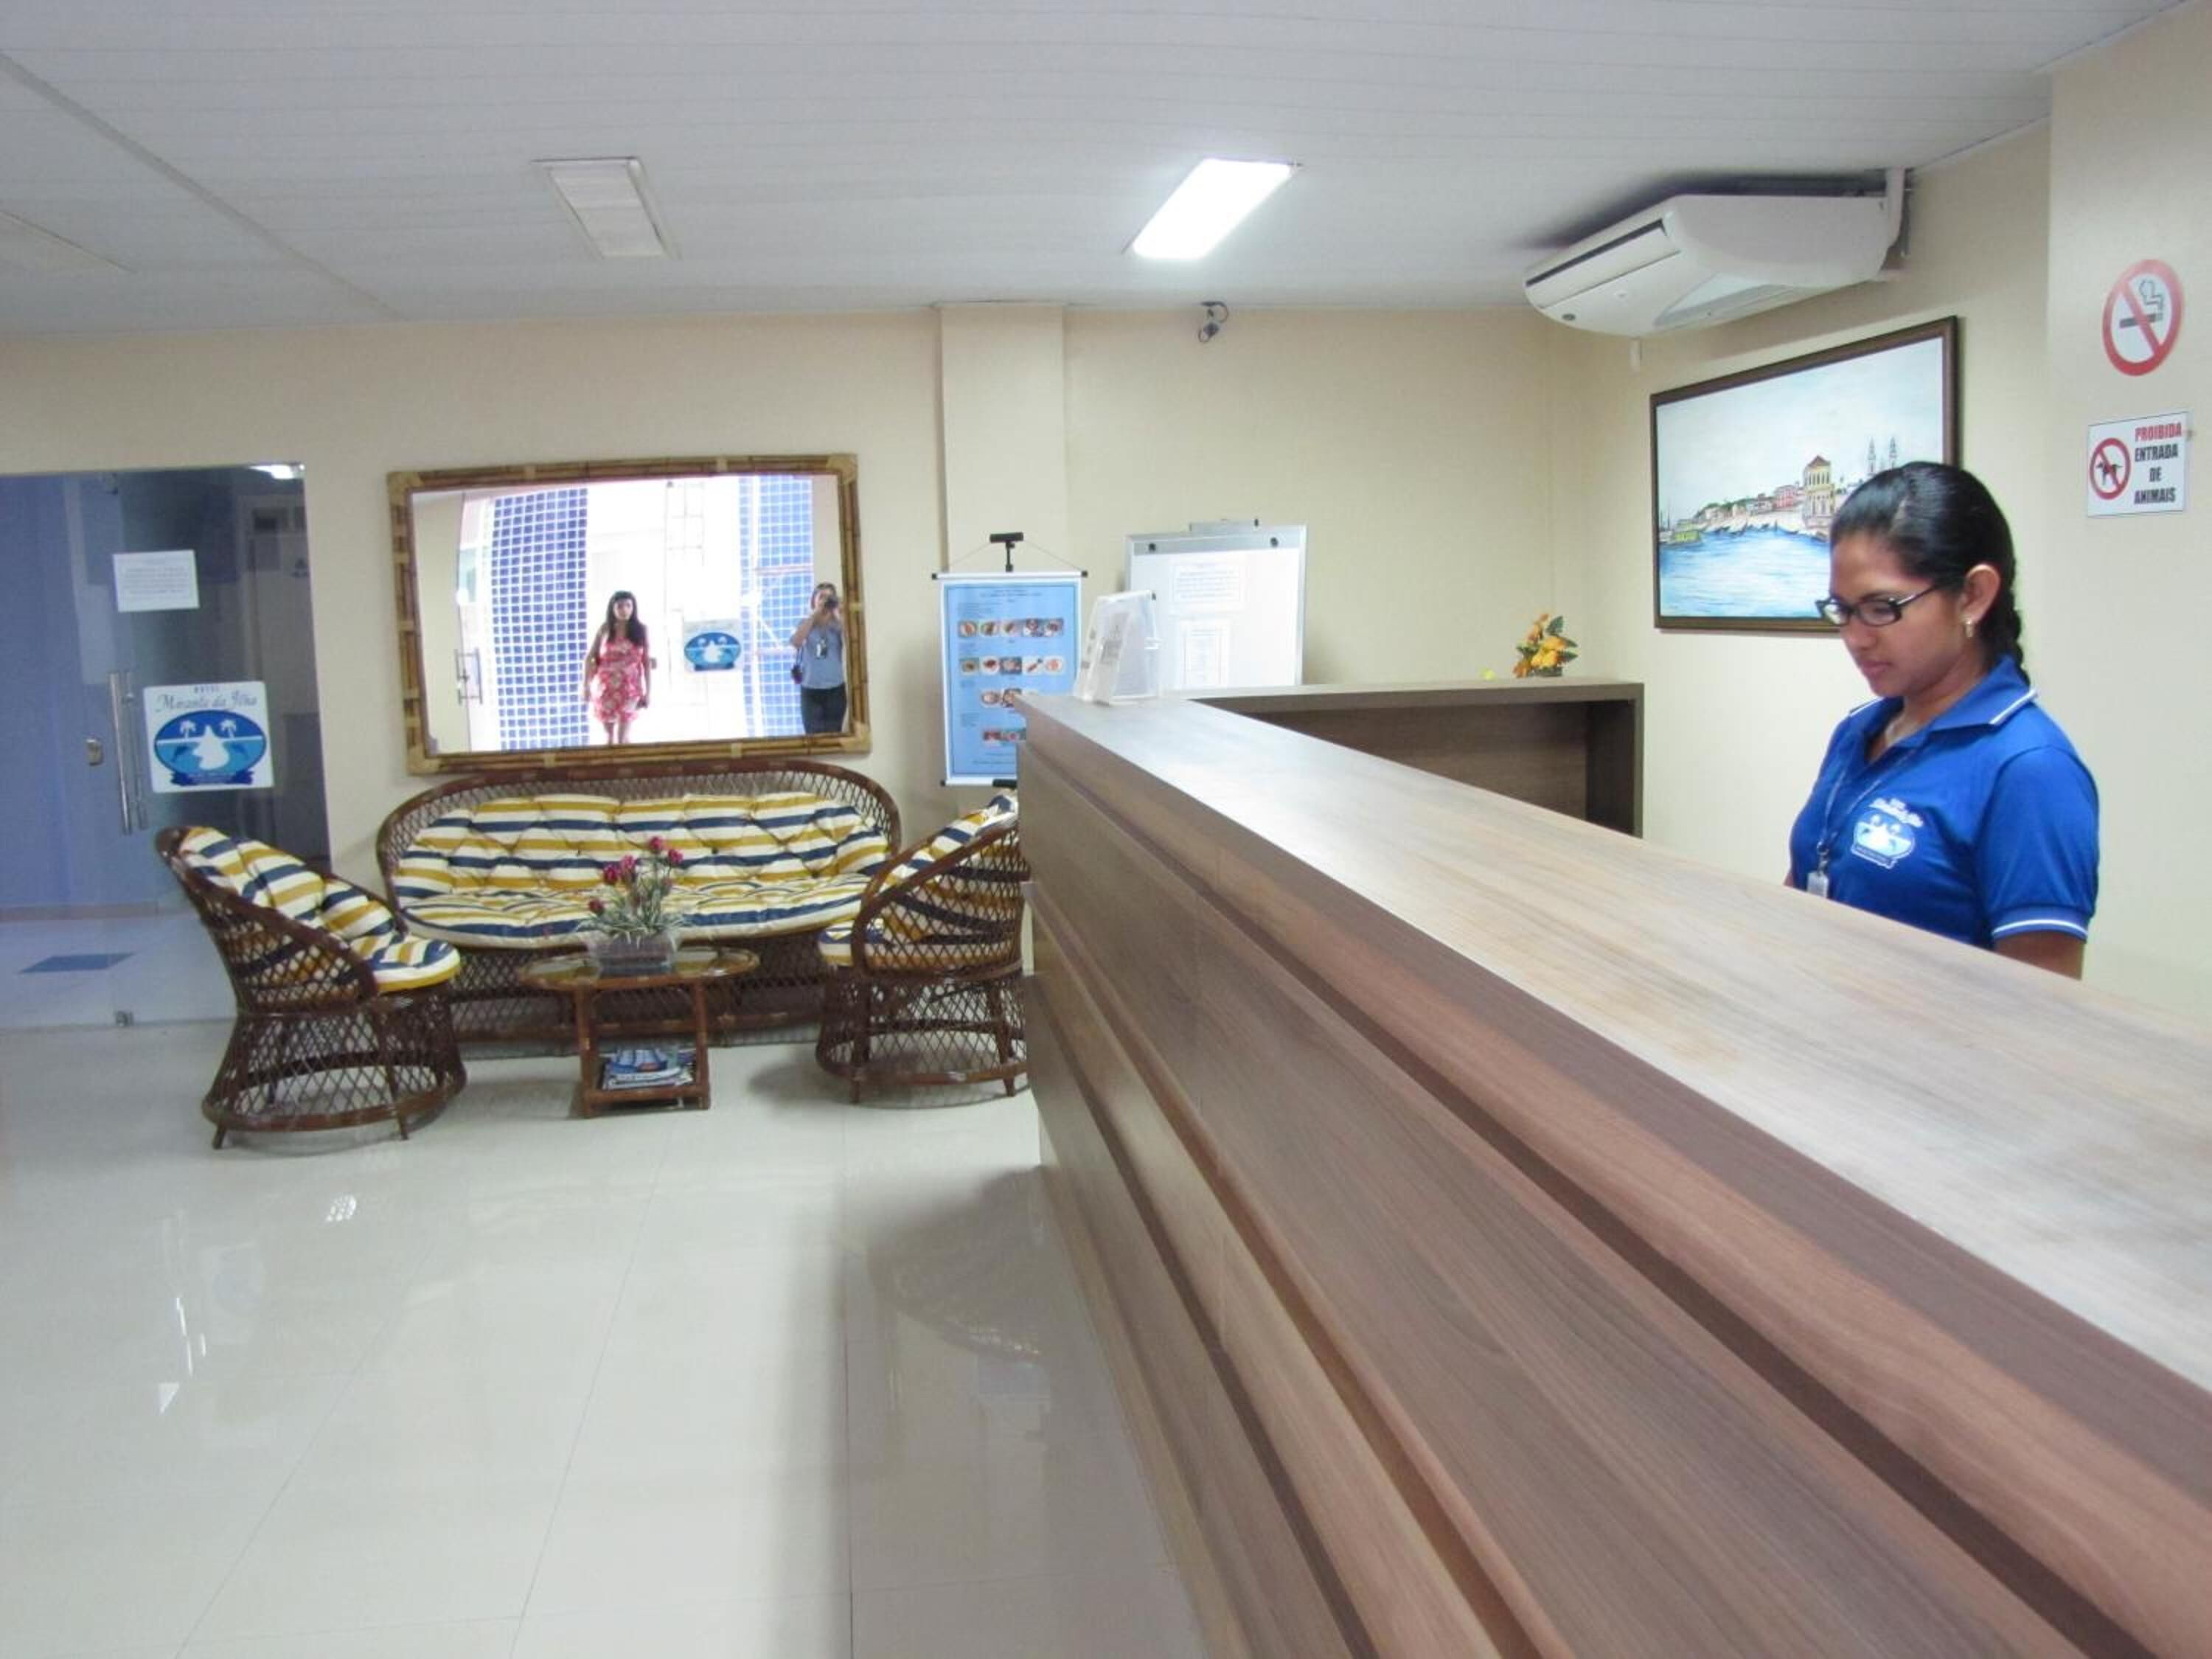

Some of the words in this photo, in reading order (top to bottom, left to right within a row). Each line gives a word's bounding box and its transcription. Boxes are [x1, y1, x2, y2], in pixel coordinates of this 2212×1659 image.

[2135, 422, 2182, 442] PROIBIDA
[2135, 443, 2178, 462] ENTRADA
[2149, 466, 2162, 482] DE
[2134, 487, 2176, 504] ANIMAIS
